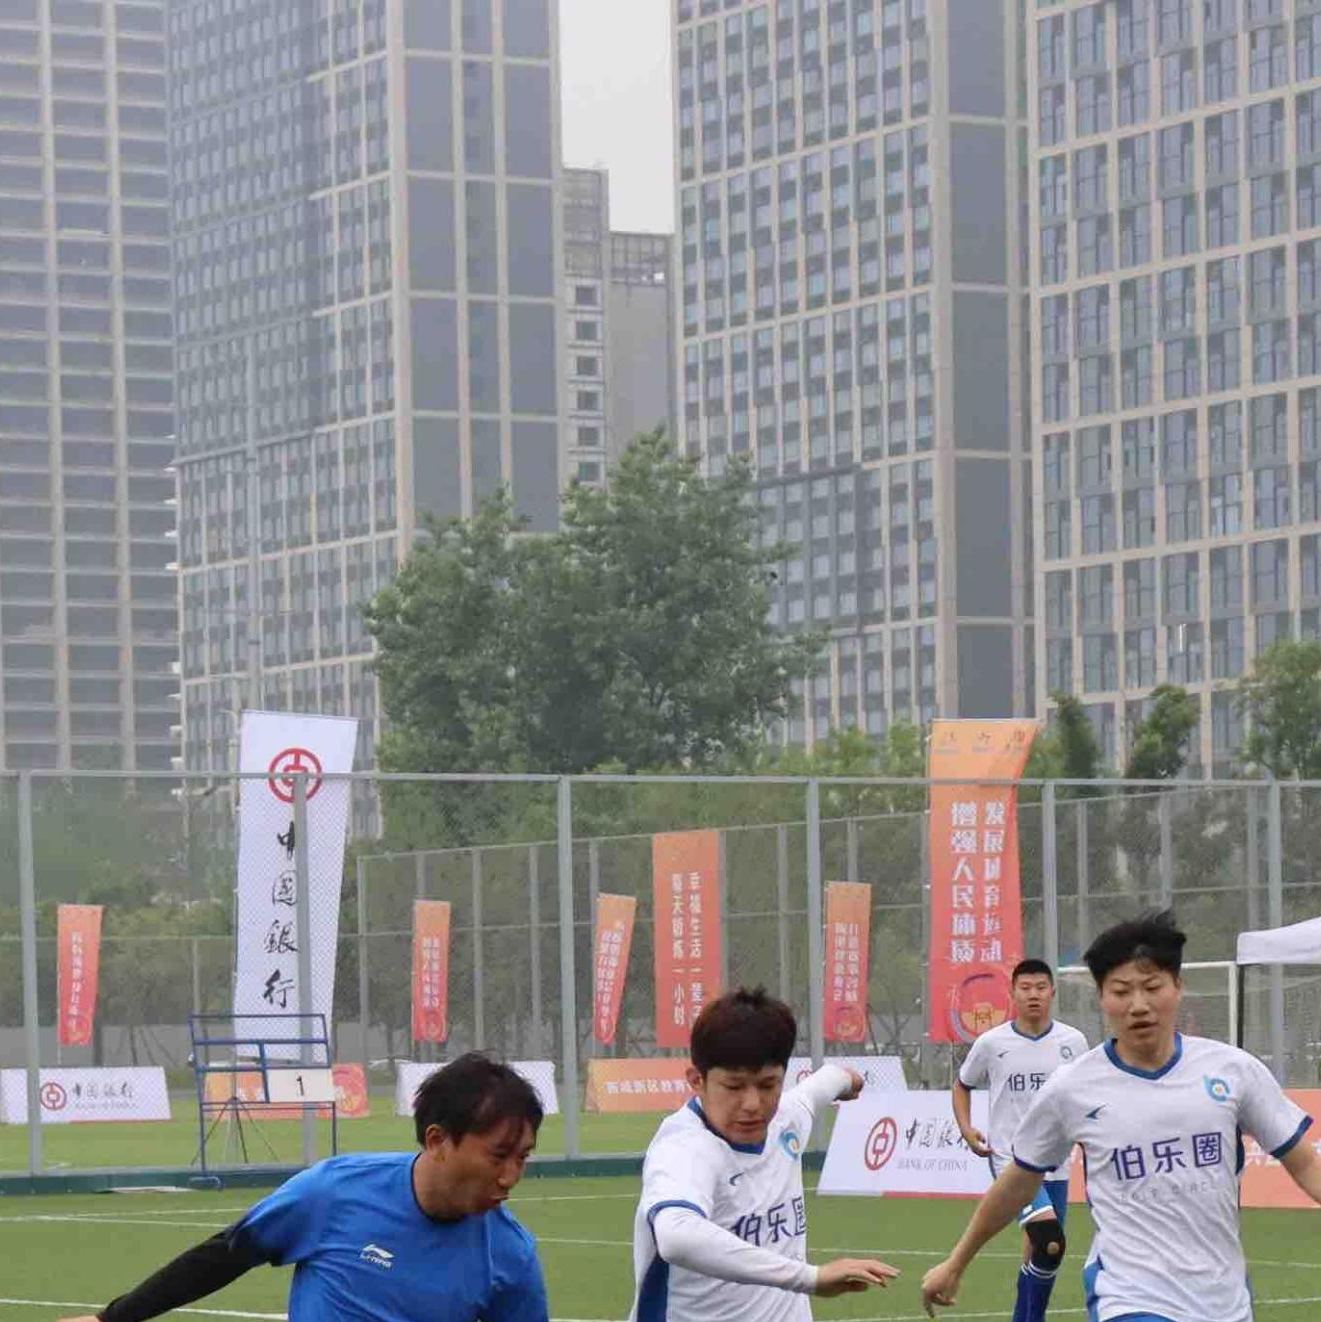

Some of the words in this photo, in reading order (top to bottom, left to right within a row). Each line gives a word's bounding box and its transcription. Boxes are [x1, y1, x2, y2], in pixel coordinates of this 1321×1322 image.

[296, 1075, 305, 1097] 1
[1110, 1131, 1223, 1181] 伯乐圈
